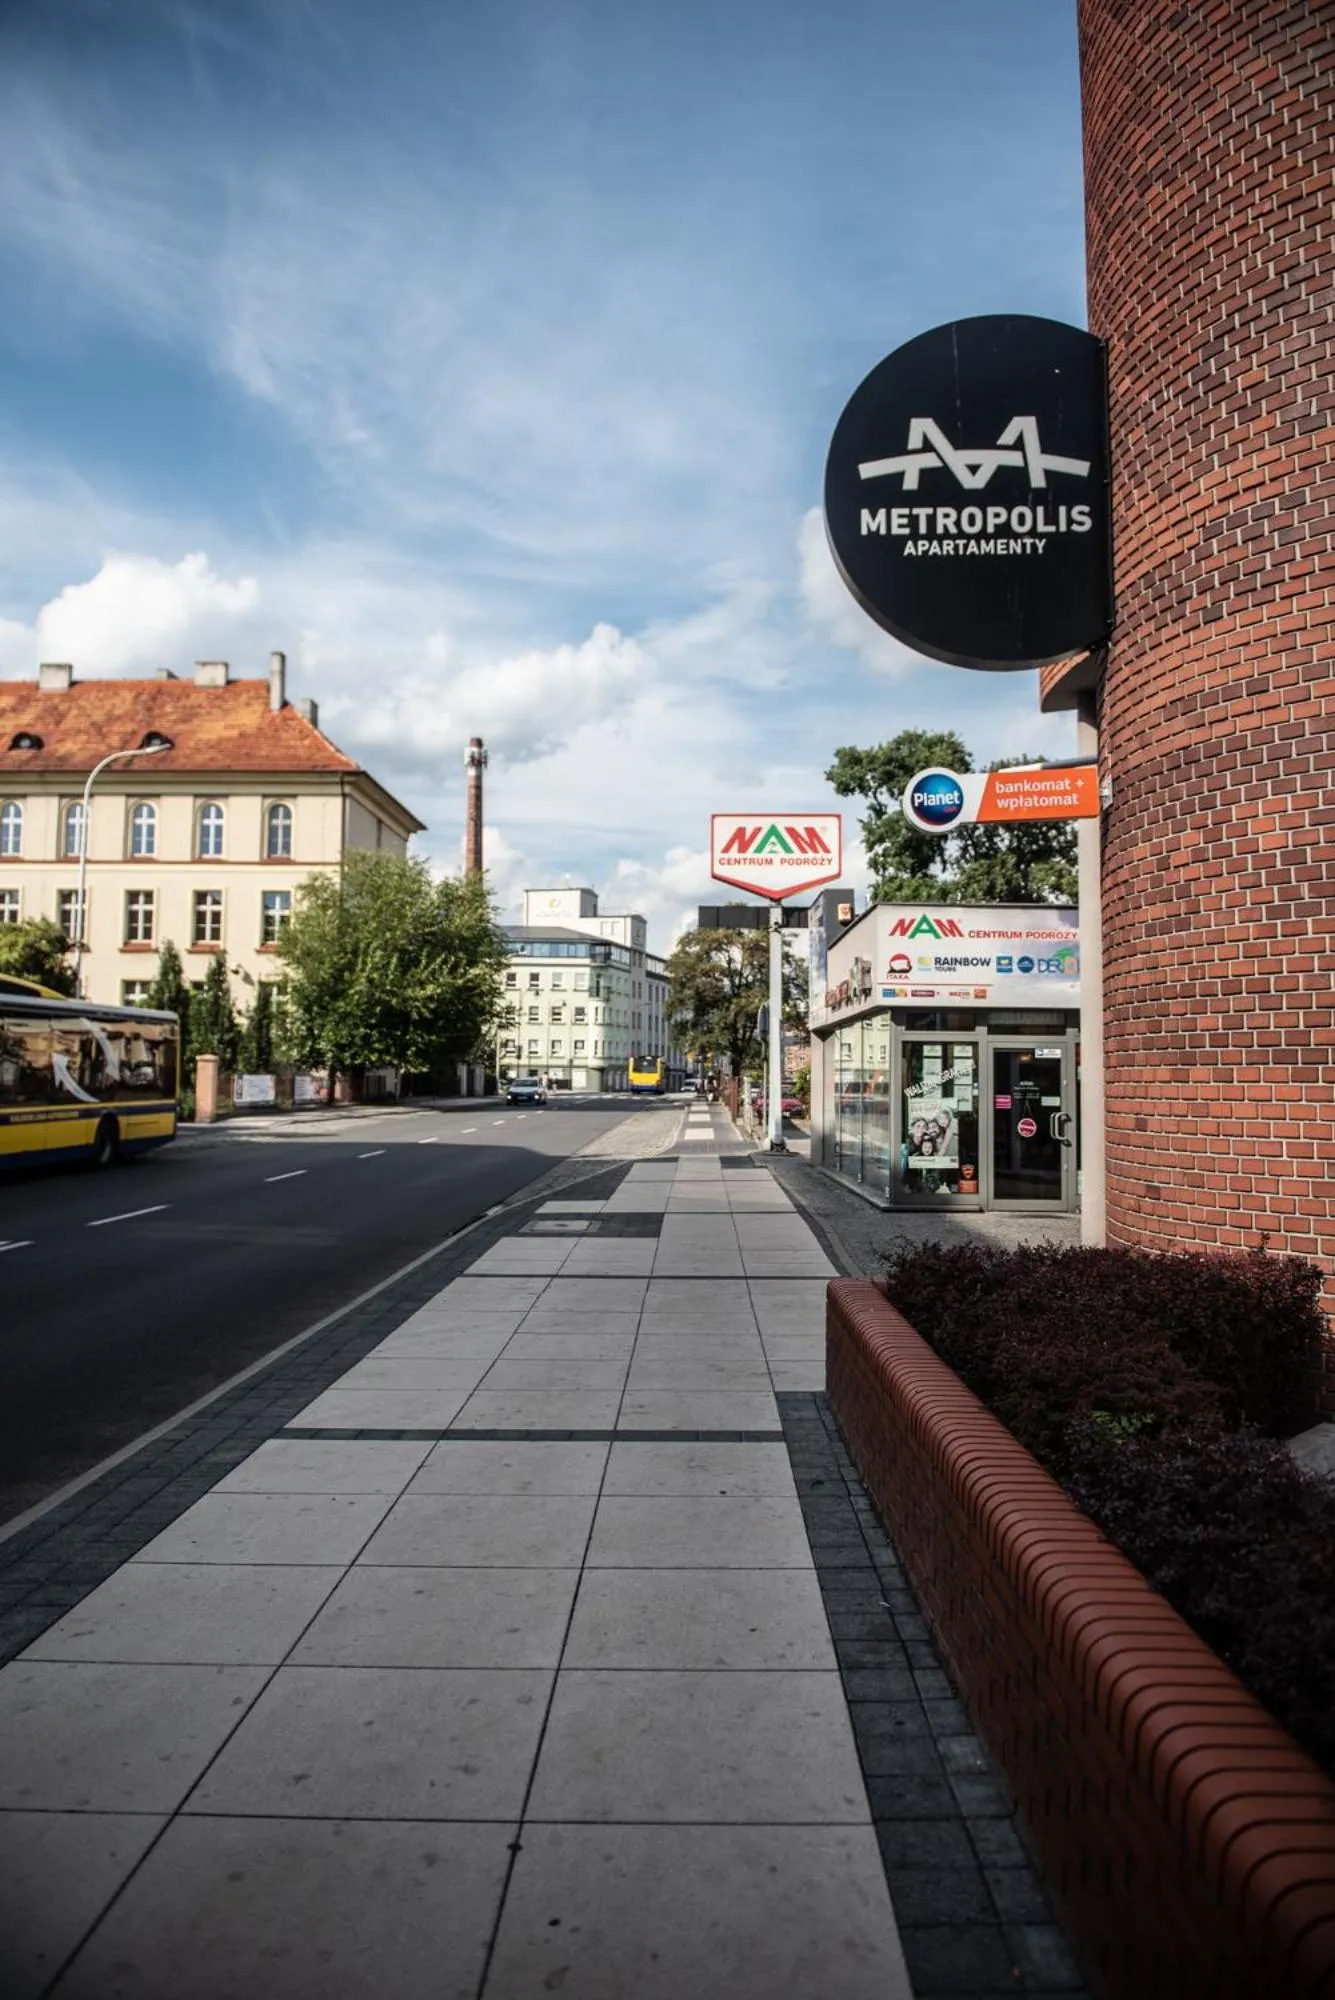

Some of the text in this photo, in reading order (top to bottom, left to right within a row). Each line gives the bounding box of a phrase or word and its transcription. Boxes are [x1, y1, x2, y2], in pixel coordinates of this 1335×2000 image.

[860, 504, 1093, 536] METROPOLIS
[903, 538, 1047, 556] APARTAMENTY
[995, 777, 1072, 794] bankomat
[913, 790, 961, 808] Planet
[996, 793, 1079, 811] wpłatomat
[720, 823, 832, 854] NAM
[718, 857, 774, 866] CENTRUM
[888, 914, 965, 939] NAM
[968, 930, 1023, 939] CENTRUM
[934, 956, 991, 967] RAINBOW
[886, 972, 910, 980] ITAKA
